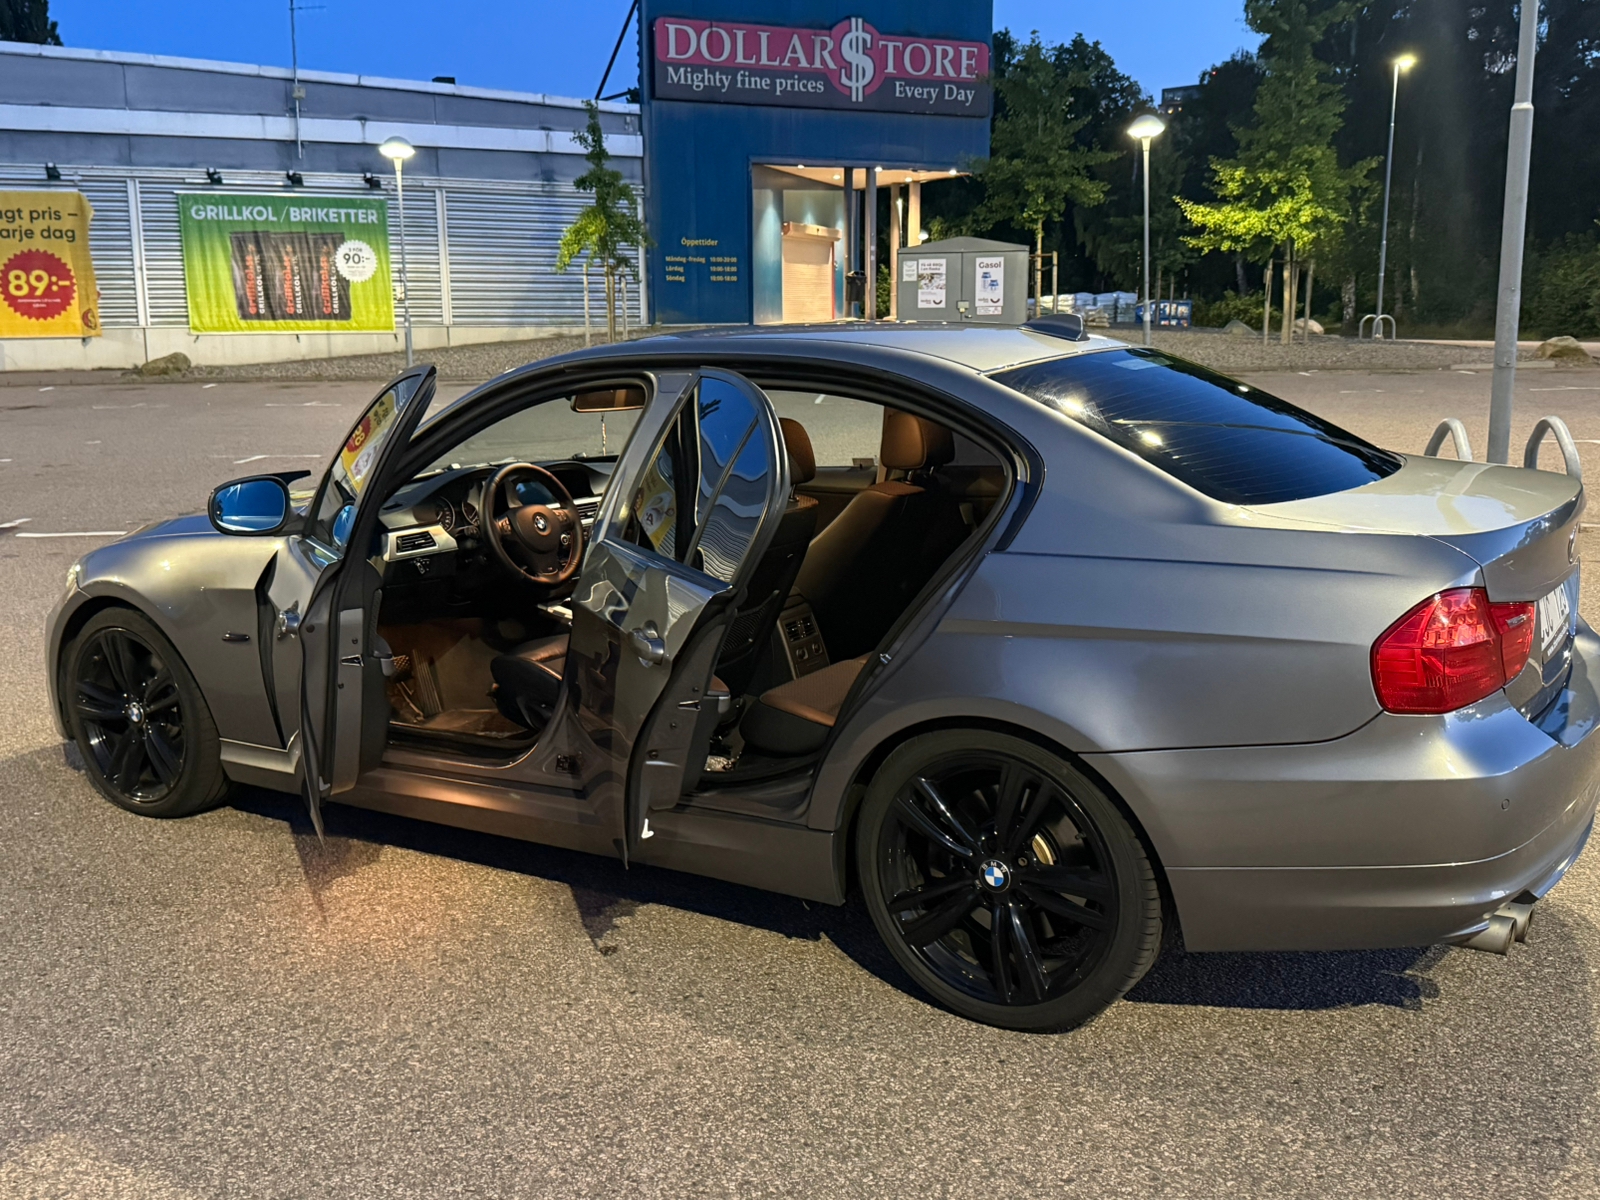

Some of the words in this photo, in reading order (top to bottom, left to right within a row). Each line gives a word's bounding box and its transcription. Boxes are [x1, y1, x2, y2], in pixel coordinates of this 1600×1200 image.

[666, 66, 732, 92] Mighty
[736, 71, 771, 90] fine
[775, 73, 825, 95] prices
[894, 81, 940, 104] Every
[943, 84, 976, 106] Day
[29, 207, 62, 223] pris
[40, 225, 76, 243] dag
[681, 237, 718, 247] Öppettider
[343, 253, 371, 265] 90:-
[978, 261, 1001, 269] Gasol
[665, 265, 684, 273] Lördag
[8, 269, 71, 297] 89:-
[665, 275, 686, 283] Söndag
[256, 274, 265, 315] GRILLKOL
[294, 274, 303, 315] GRILLKOL
[330, 275, 340, 315] GRILLKOL
[982, 862, 1007, 872] BMW
